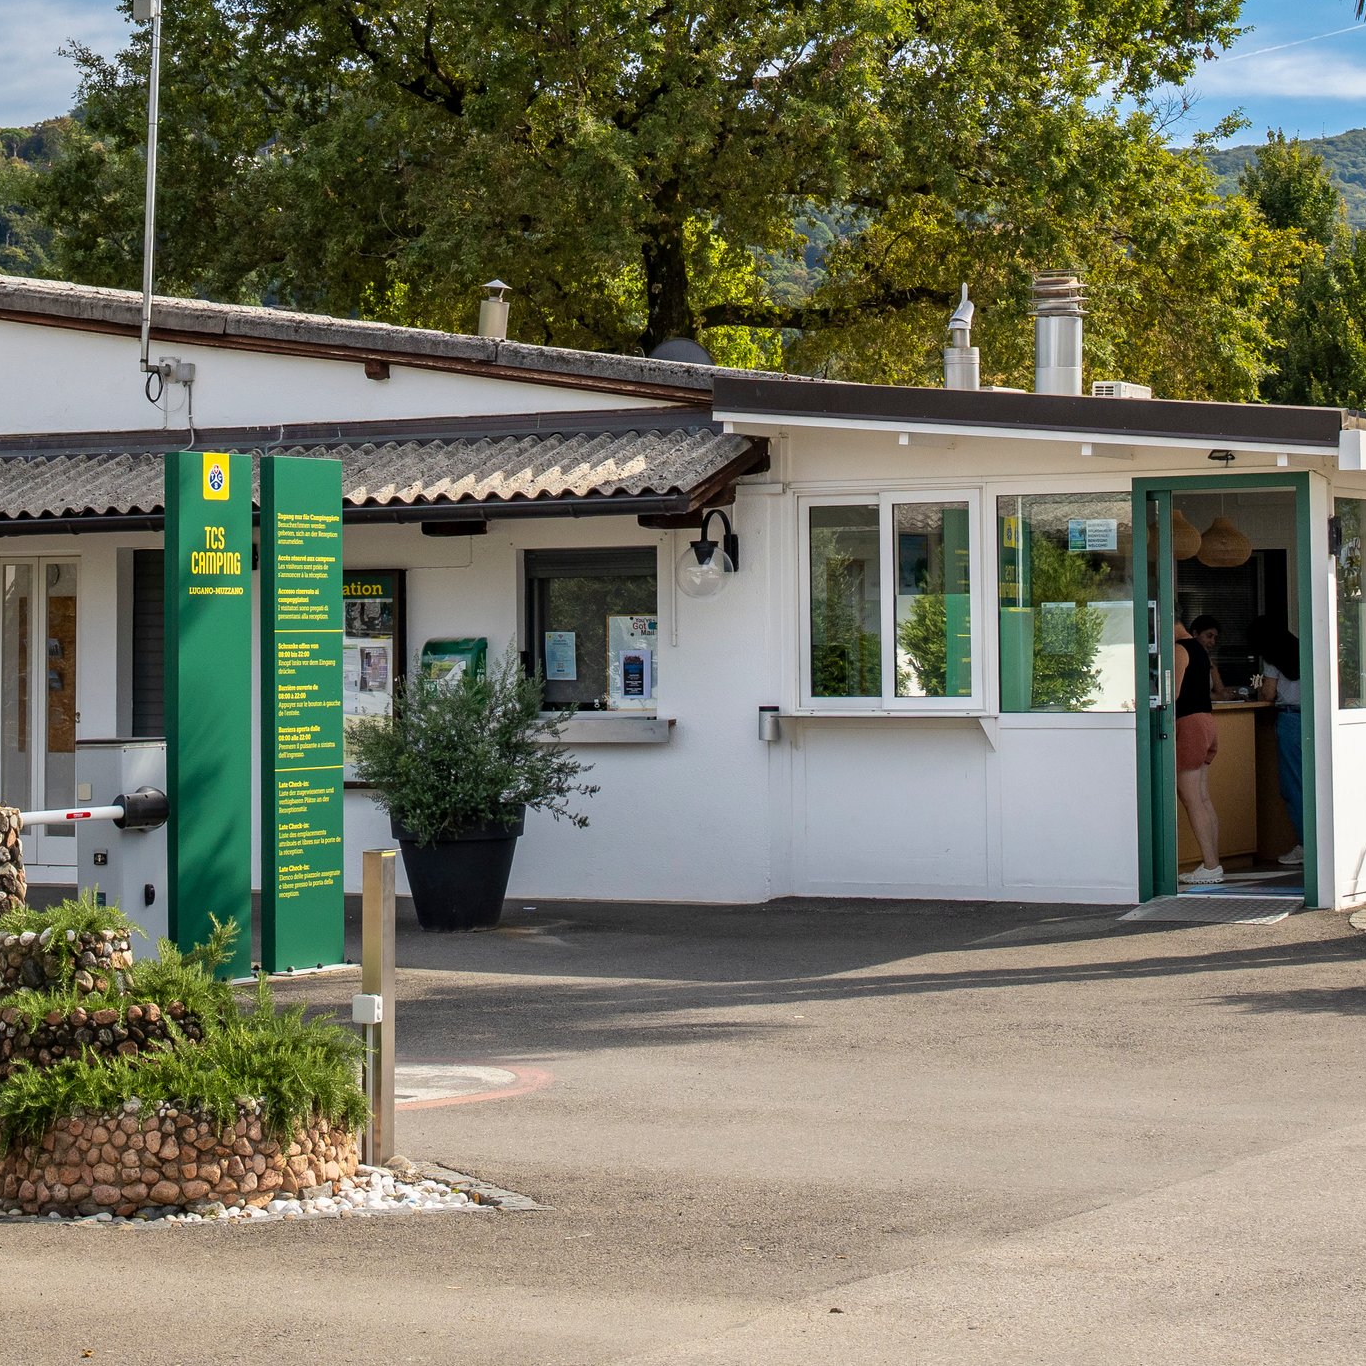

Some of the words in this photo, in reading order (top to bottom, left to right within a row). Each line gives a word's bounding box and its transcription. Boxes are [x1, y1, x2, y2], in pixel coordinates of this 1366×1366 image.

[205, 526, 225, 549] TCS
[191, 552, 241, 574] CAMPING
[189, 587, 243, 595] LUGANO-MUZZANO
